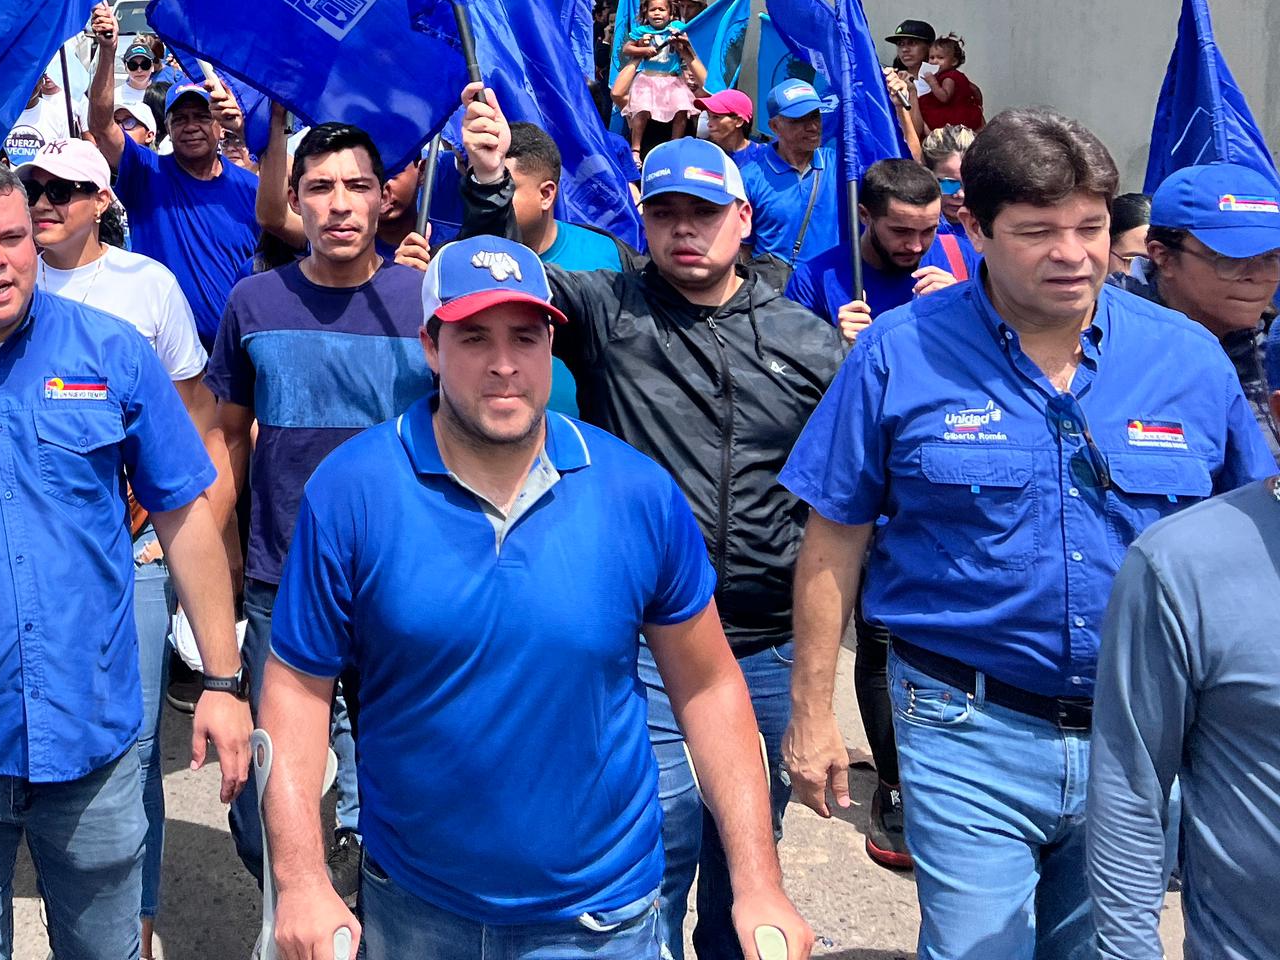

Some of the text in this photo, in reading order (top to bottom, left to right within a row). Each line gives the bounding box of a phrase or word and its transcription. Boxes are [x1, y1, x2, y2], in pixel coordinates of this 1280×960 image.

[6, 139, 41, 148] FUERZA
[42, 140, 68, 155] NY
[7, 148, 37, 156] VECINA
[945, 413, 990, 425] Unidad
[944, 431, 1007, 440] Gilberto Román
